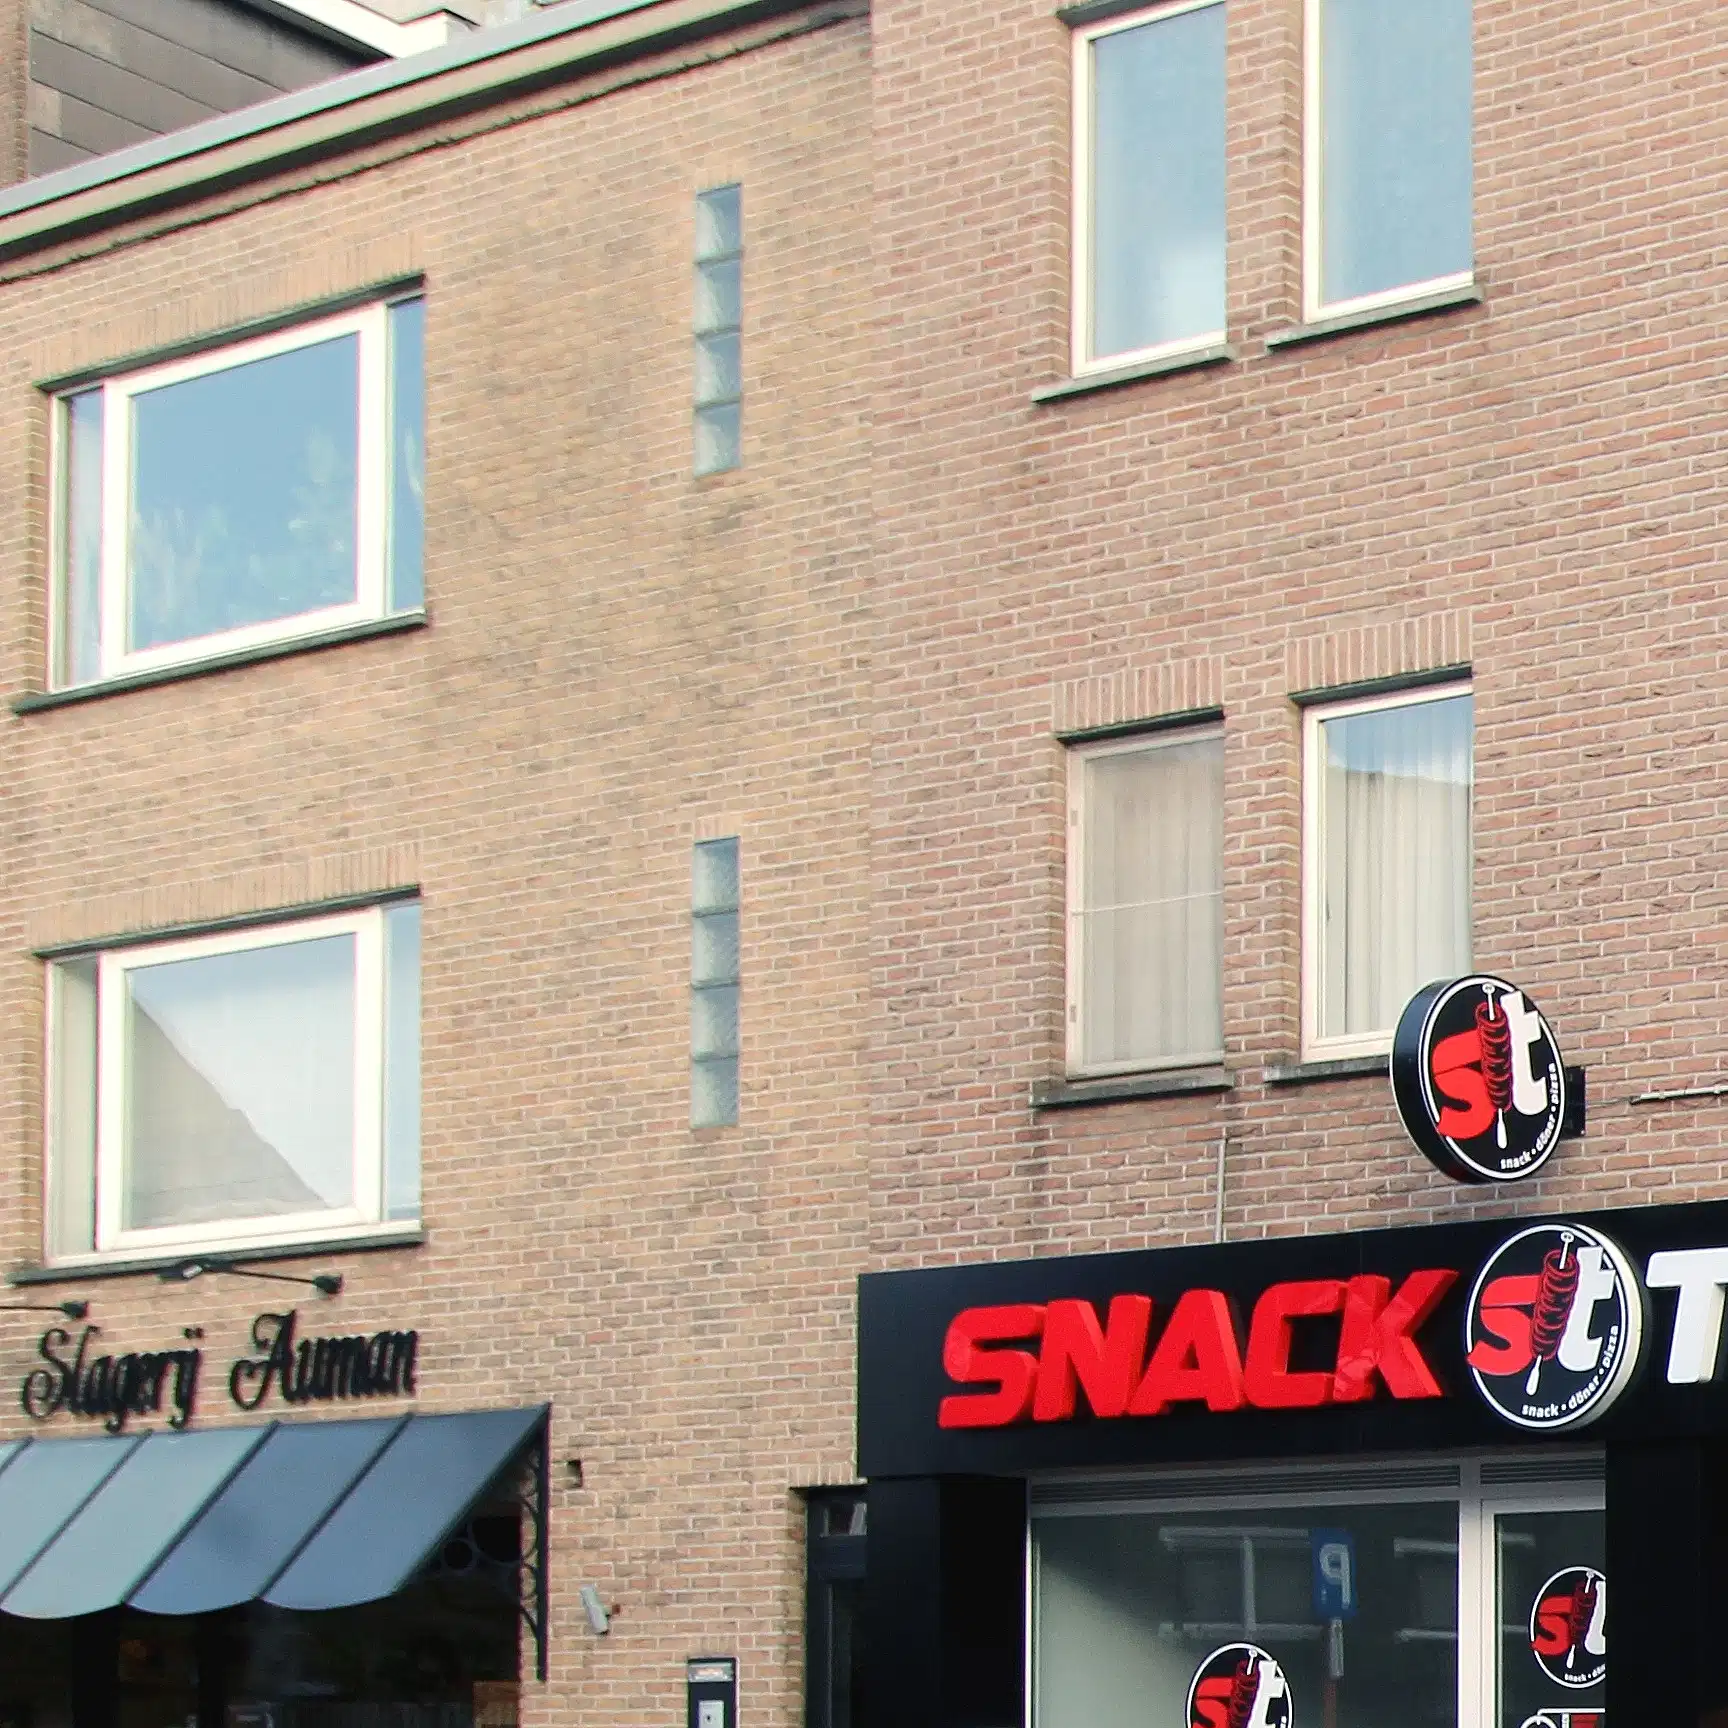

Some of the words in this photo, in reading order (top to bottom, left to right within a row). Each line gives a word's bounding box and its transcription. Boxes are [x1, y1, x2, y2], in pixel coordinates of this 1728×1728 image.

[1500, 1150, 1532, 1170] snack
[1535, 1117, 1557, 1152] döner
[1548, 1062, 1559, 1105] pizza
[229, 1308, 421, 1411] Auman
[938, 1268, 1460, 1430] SNACK
[1521, 1403, 1560, 1418] snack
[1568, 1374, 1600, 1409] döner
[1602, 1325, 1619, 1368] pizza
